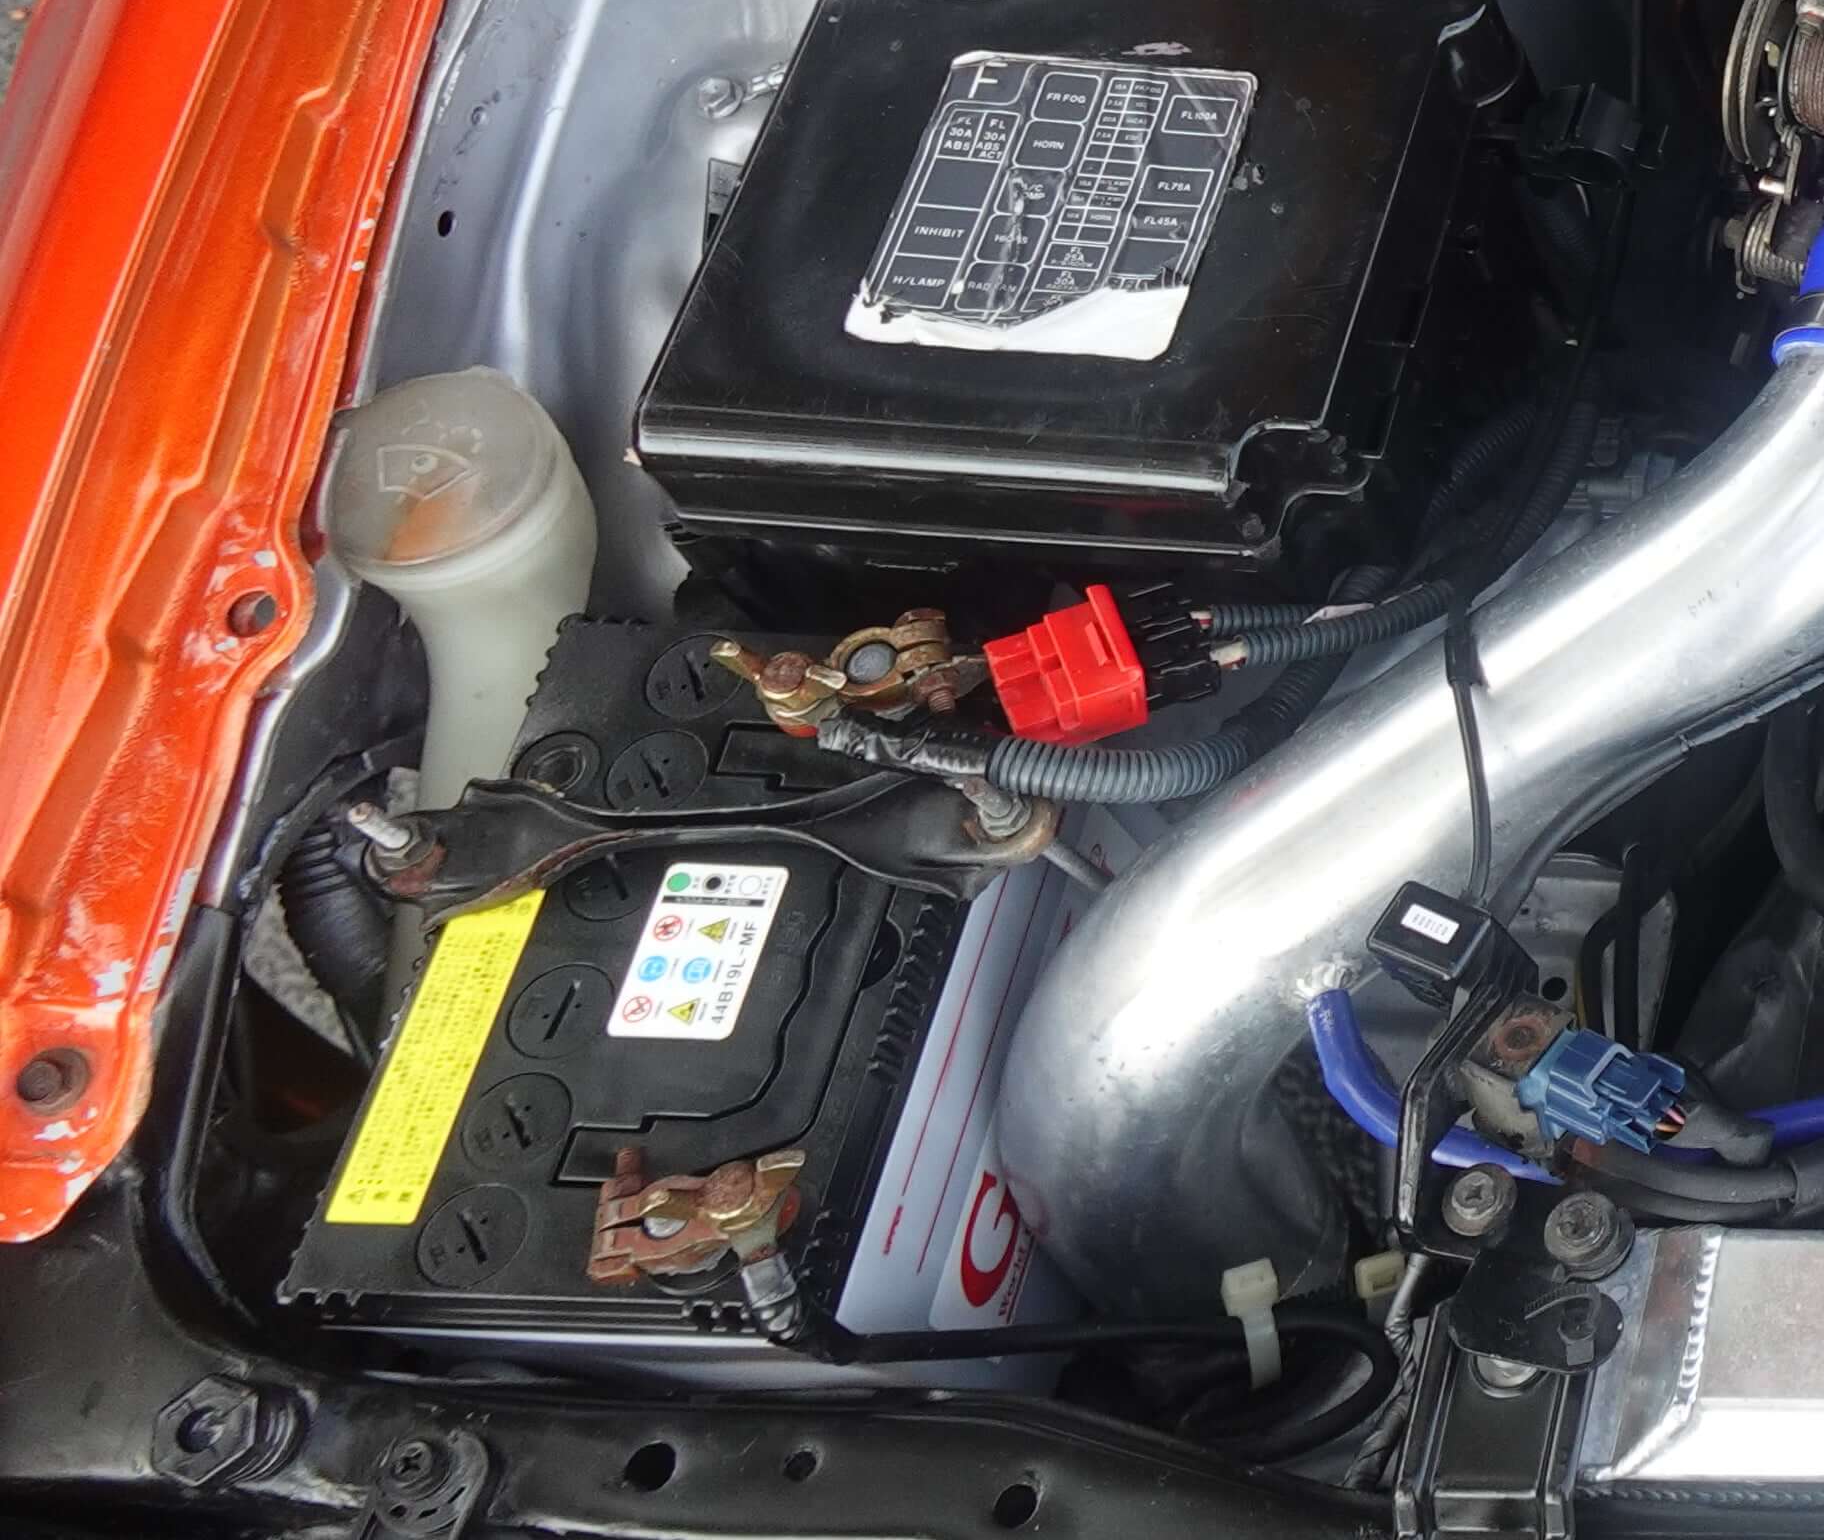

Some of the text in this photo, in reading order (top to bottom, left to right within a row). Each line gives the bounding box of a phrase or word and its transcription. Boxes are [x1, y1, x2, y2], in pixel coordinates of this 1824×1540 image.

[968, 62, 1008, 99] F
[1063, 94, 1086, 104] FOG
[950, 127, 972, 138] 30A
[984, 131, 1006, 142] 30A
[944, 139, 970, 151] ABS
[976, 141, 1000, 151] ABS
[1033, 139, 1064, 150] HORN
[914, 225, 965, 238] INHIBIT
[892, 275, 946, 288] H/LAMP
[711, 920, 759, 1025] 44B19L-MF
